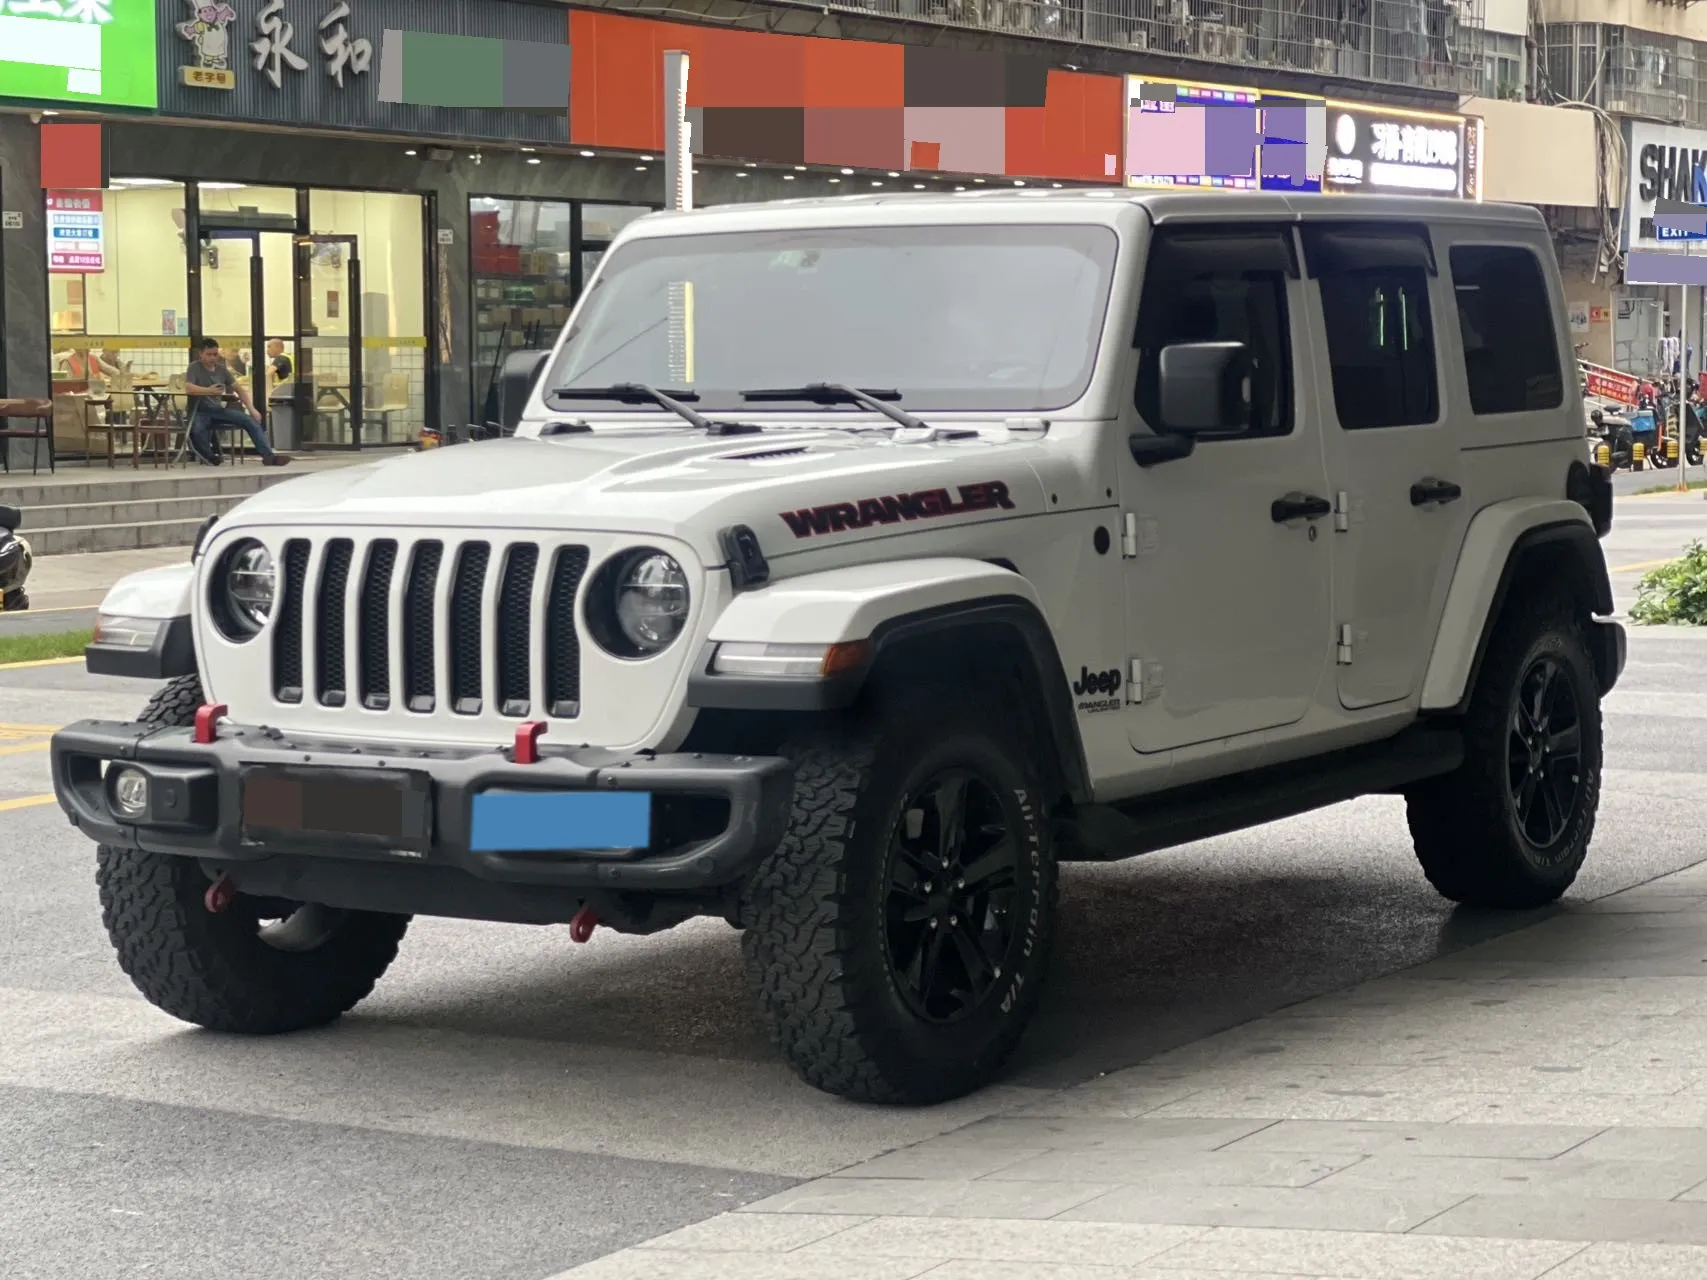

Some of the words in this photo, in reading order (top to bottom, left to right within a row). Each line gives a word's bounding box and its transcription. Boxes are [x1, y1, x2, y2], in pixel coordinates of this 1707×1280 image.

[249, 0, 373, 89] 永和
[191, 70, 227, 85] 老字号
[778, 480, 1016, 539] WRANGLER
[1073, 665, 1122, 697] Jeep
